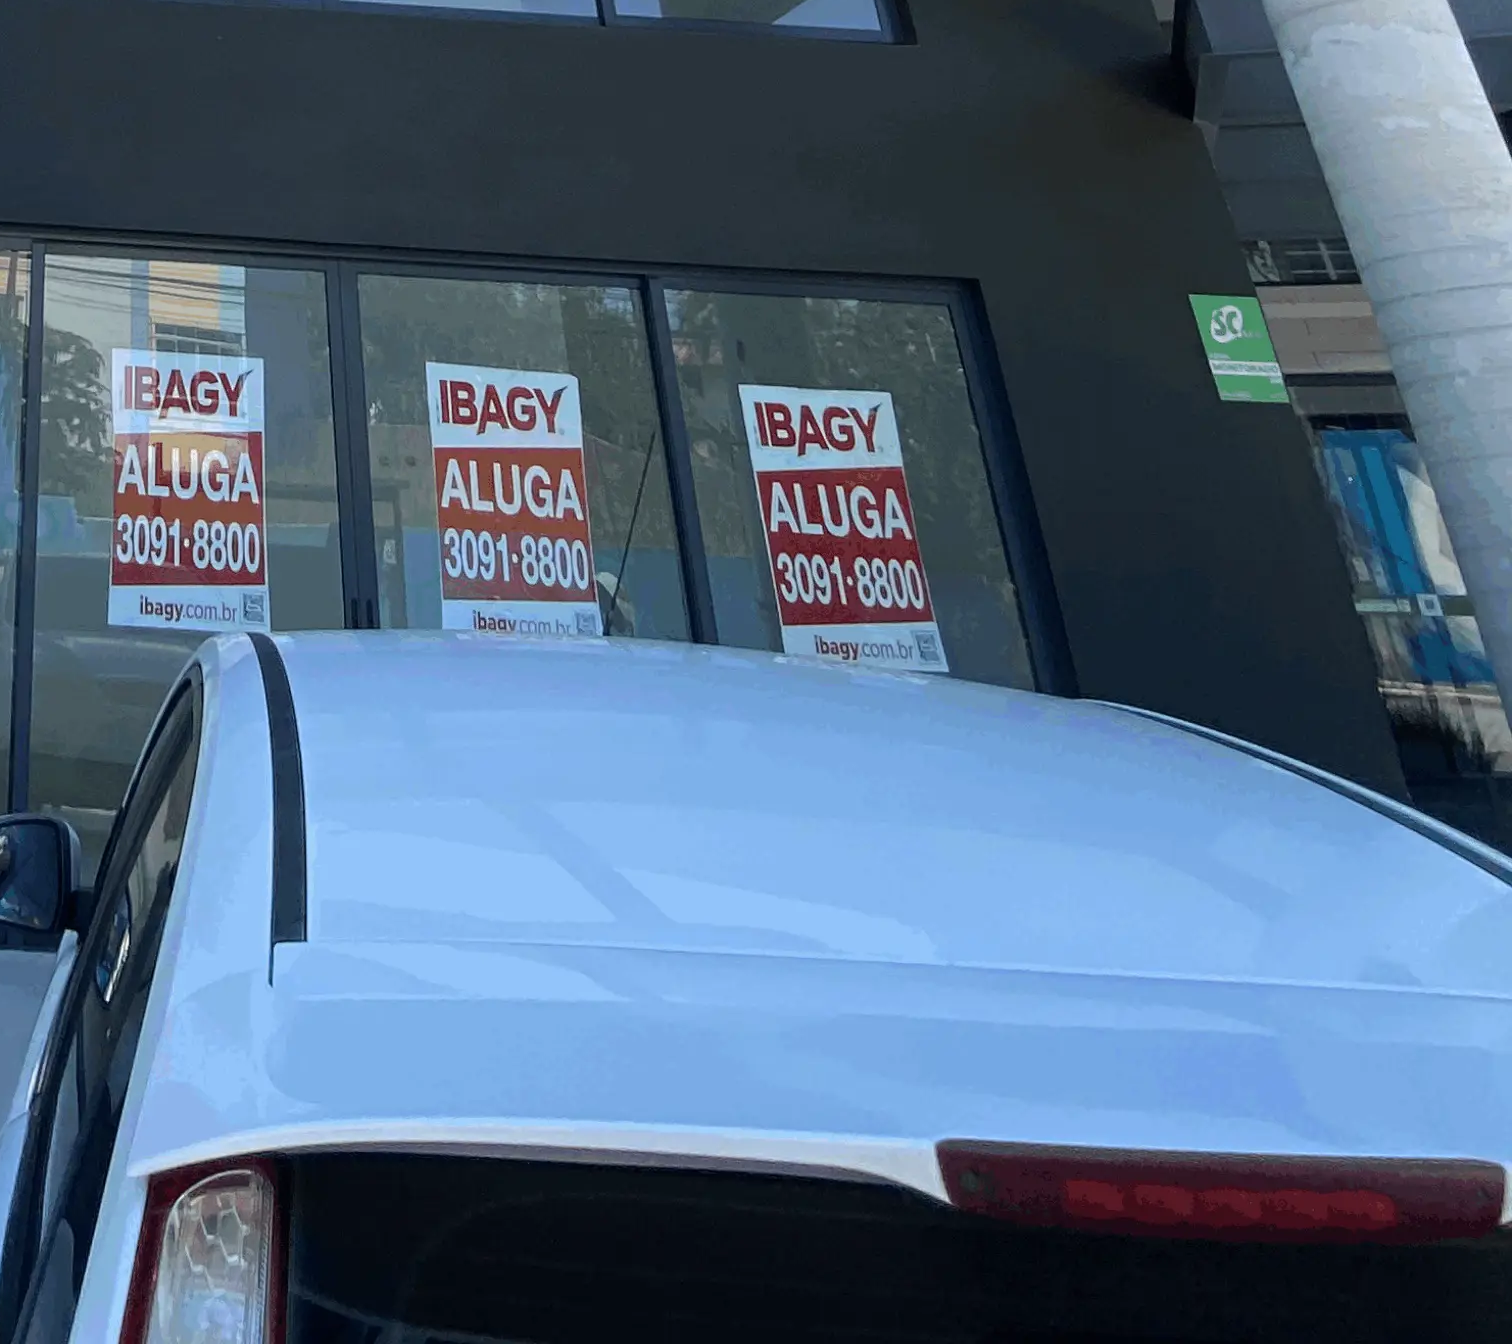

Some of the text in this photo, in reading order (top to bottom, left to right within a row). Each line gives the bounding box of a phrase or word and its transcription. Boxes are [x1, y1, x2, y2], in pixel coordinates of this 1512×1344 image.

[1213, 310, 1238, 336] SC
[123, 365, 254, 419] IBAGY
[439, 379, 568, 436] IBAGY
[754, 401, 882, 457] IBAGY
[117, 443, 260, 505] ALUGA
[441, 458, 584, 521] ALUGA
[769, 481, 913, 540] ALUGA
[139, 594, 239, 623] ibagy.com.br
[813, 634, 914, 661] ibagy.com.br
